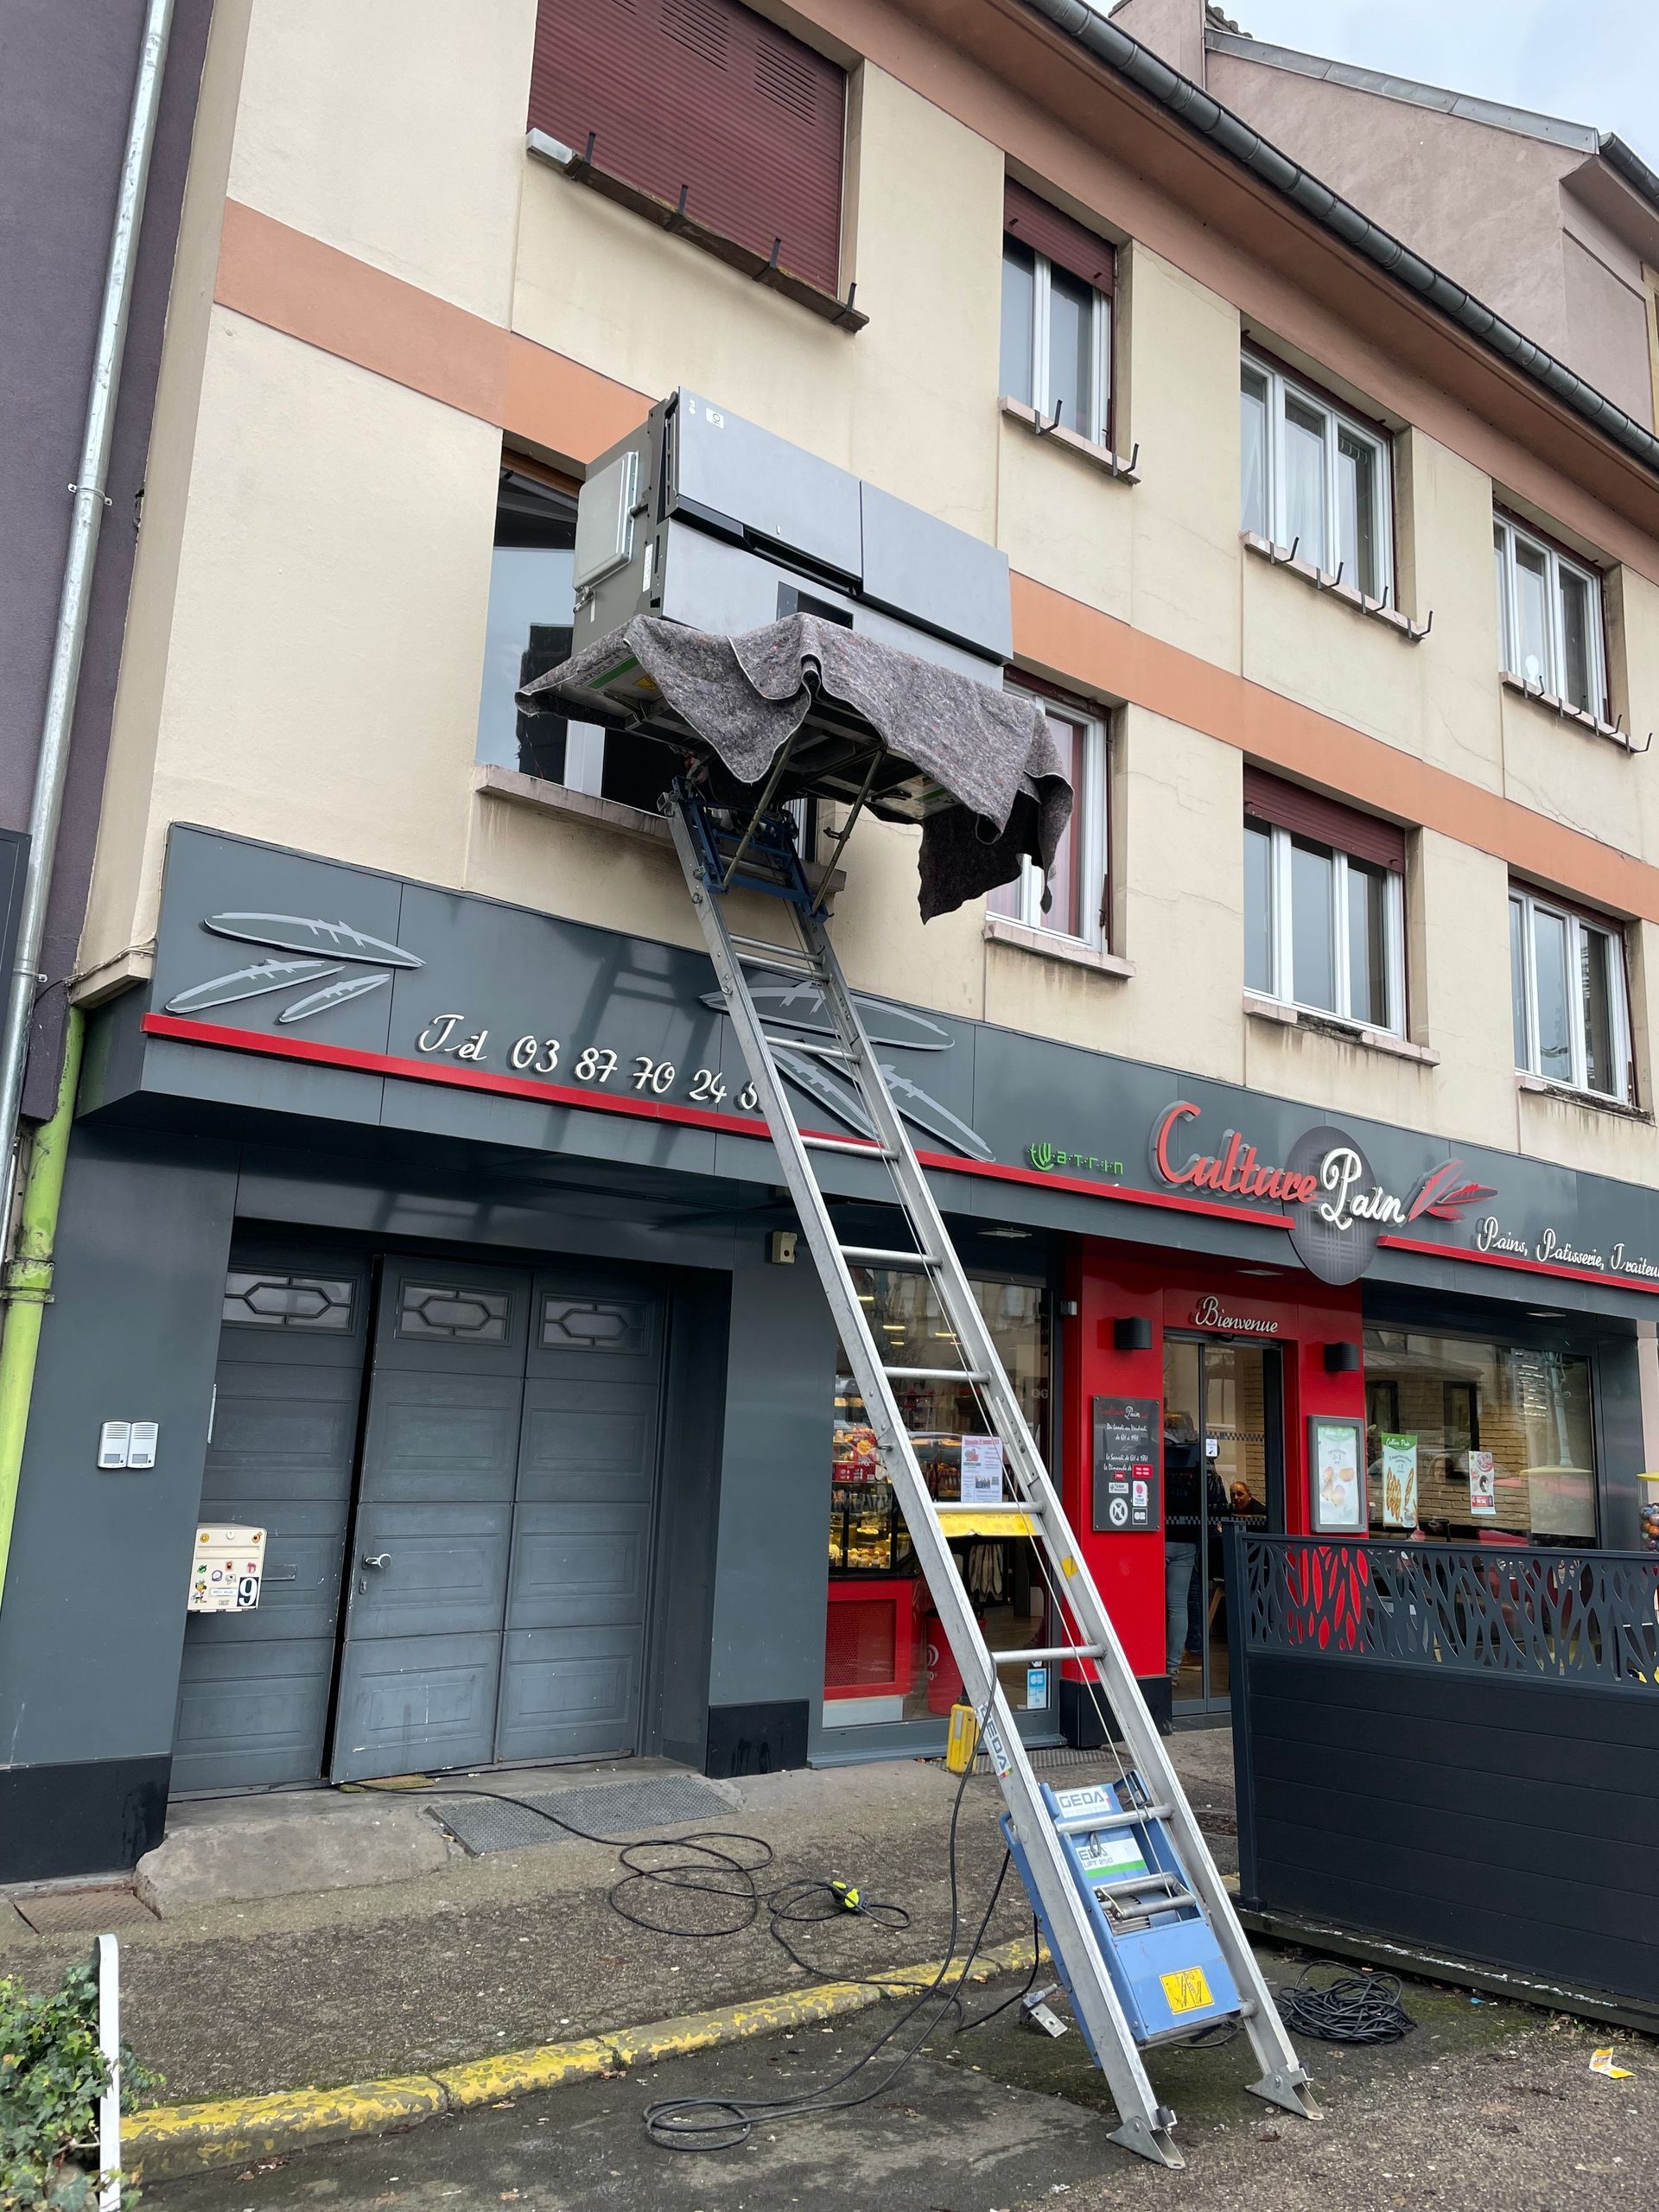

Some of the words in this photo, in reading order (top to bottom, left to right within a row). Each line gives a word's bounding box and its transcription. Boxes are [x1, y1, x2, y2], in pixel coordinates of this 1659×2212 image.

[512, 1035, 560, 1073] 03
[575, 1047, 618, 1083] 87
[632, 1057, 676, 1094] 70
[689, 1069, 728, 1103] 24
[1158, 1103, 1318, 1204] Culture
[1318, 1147, 1406, 1231] Pain
[1478, 1216, 1528, 1256] Pains,
[1195, 1296, 1278, 1332] Bienvenue
[1124, 1405, 1141, 1420] Pain
[238, 1577, 257, 1606] 9
[1058, 1790, 1105, 1808] GEDA
[1077, 1846, 1109, 1860] EDA
